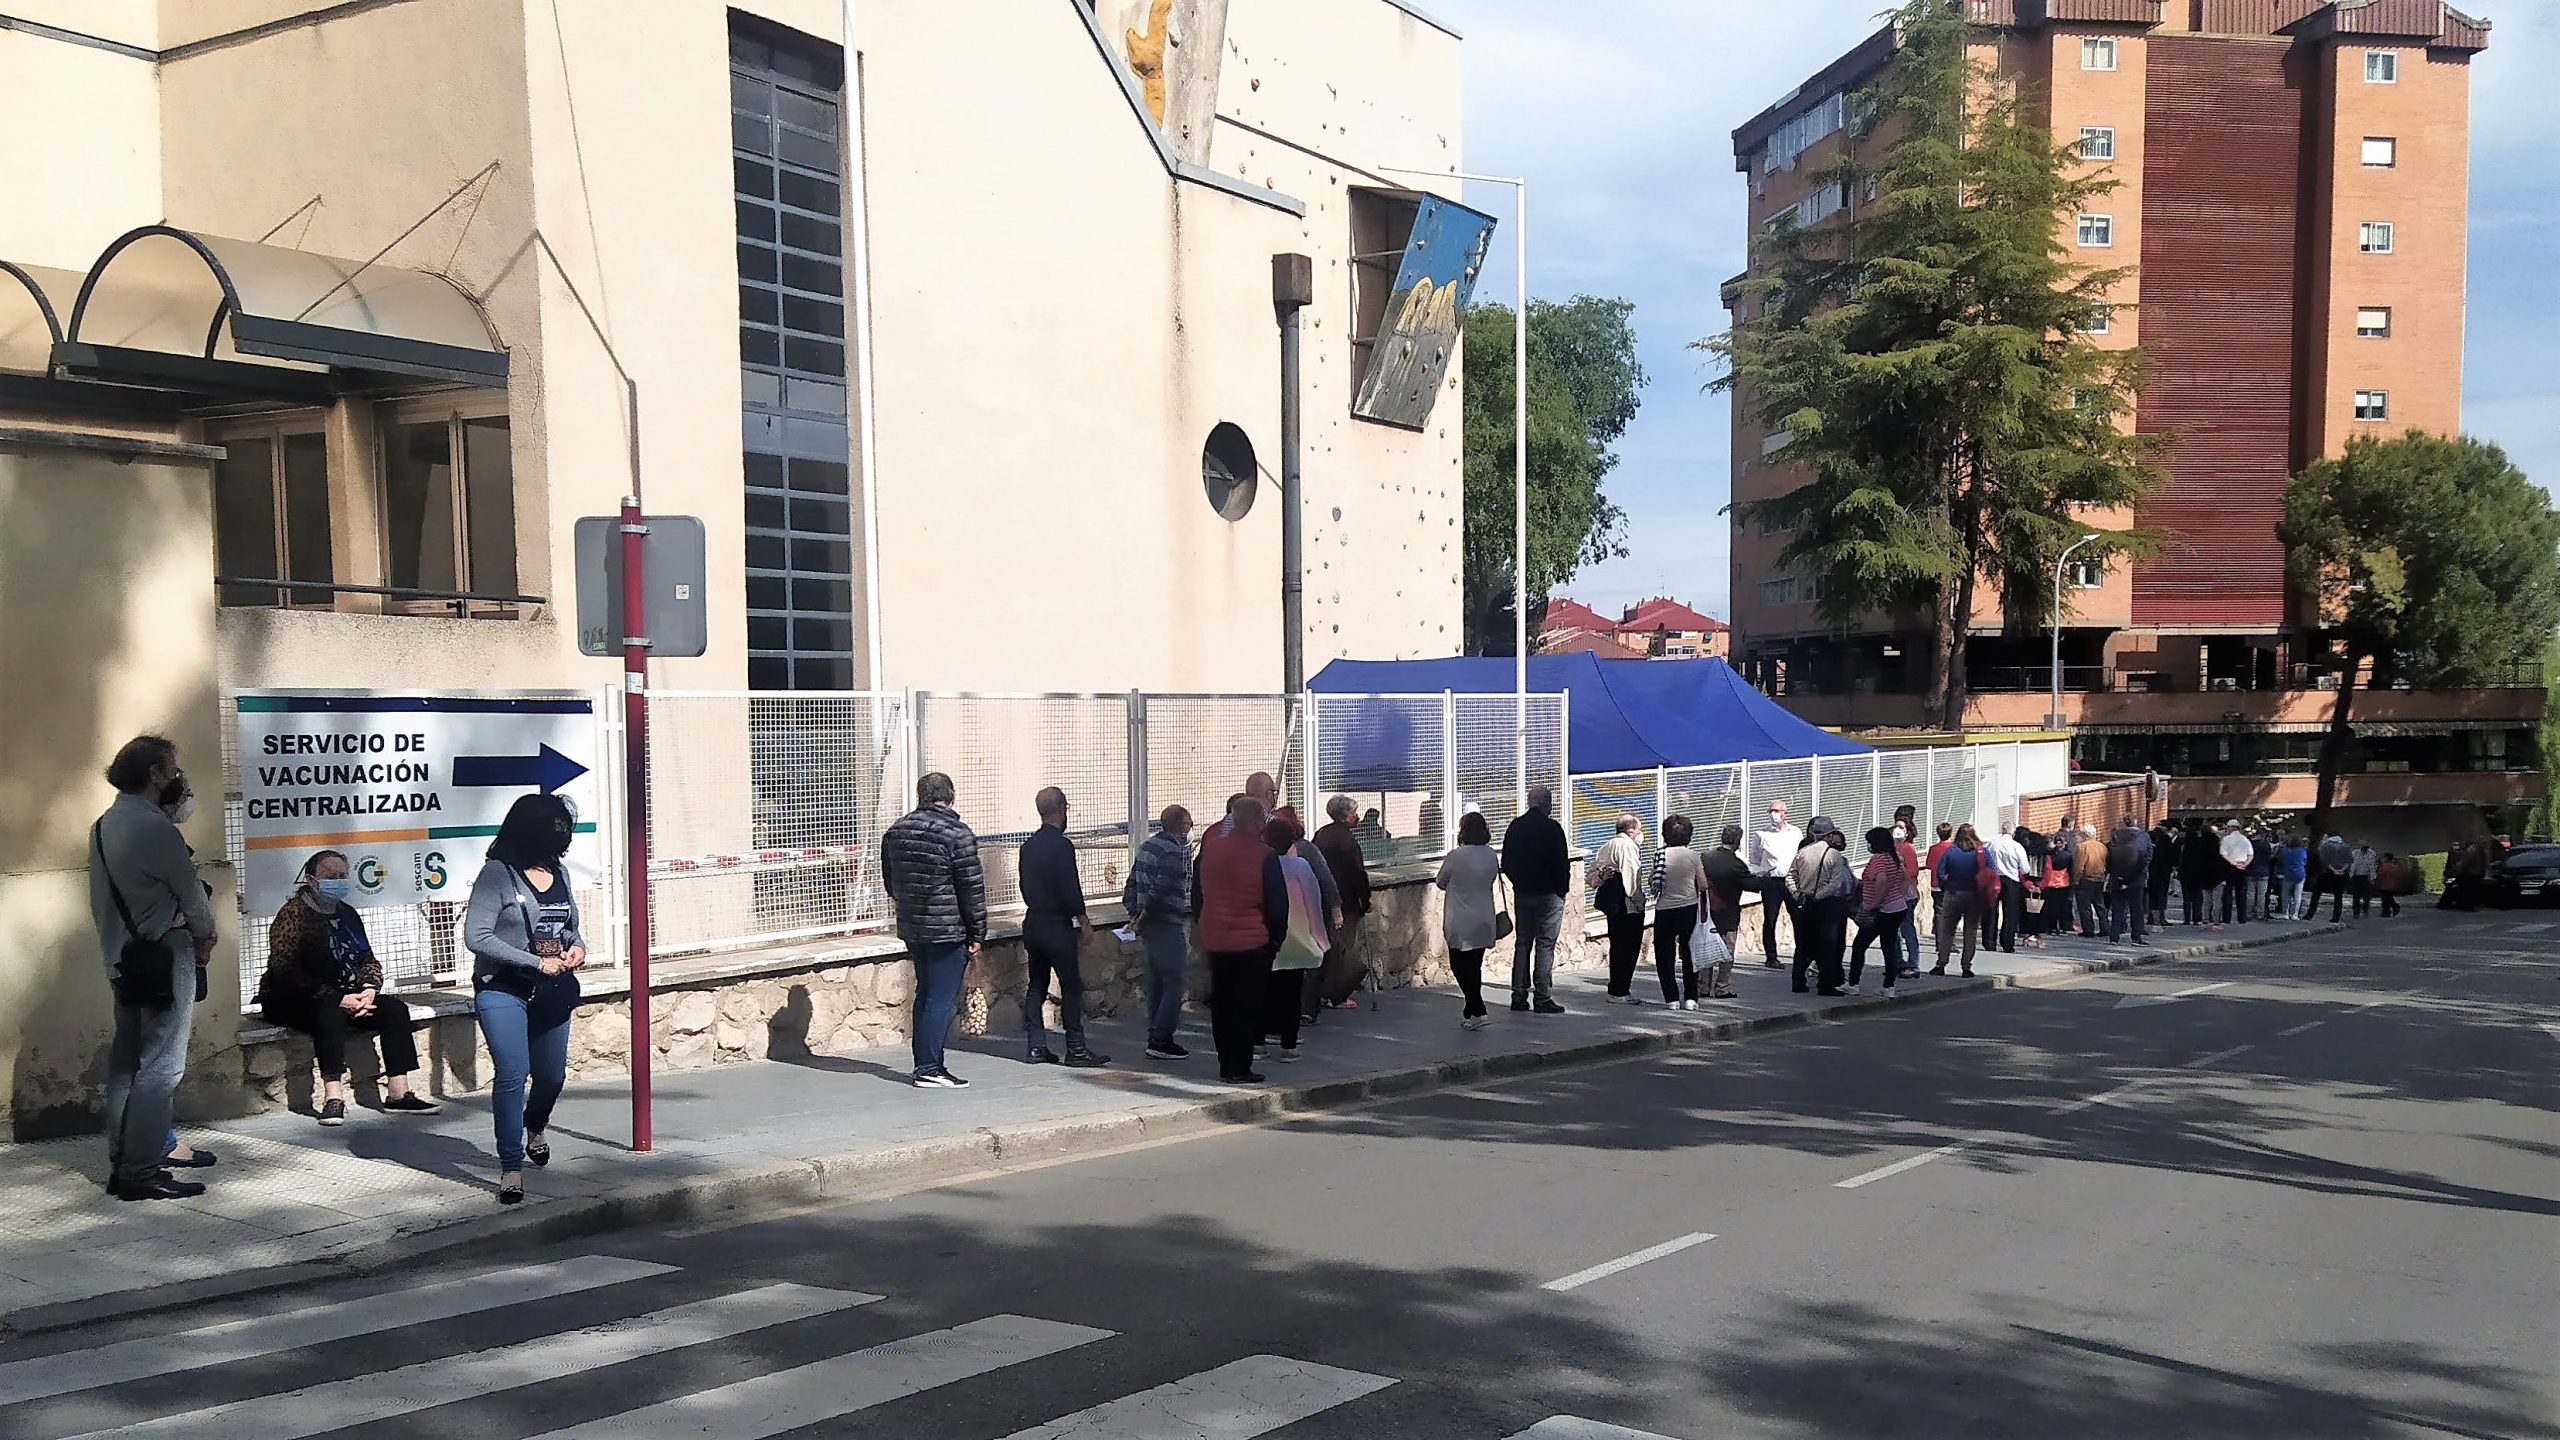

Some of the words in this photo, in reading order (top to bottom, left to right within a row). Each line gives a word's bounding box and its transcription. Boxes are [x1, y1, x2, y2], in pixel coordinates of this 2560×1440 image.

[263, 733, 385, 755] SERVICIO
[394, 733, 425, 752] DE
[258, 759, 429, 787] VACUNACIÓN
[248, 792, 442, 819] CENTRALIZADA
[413, 852, 422, 892] sescam
